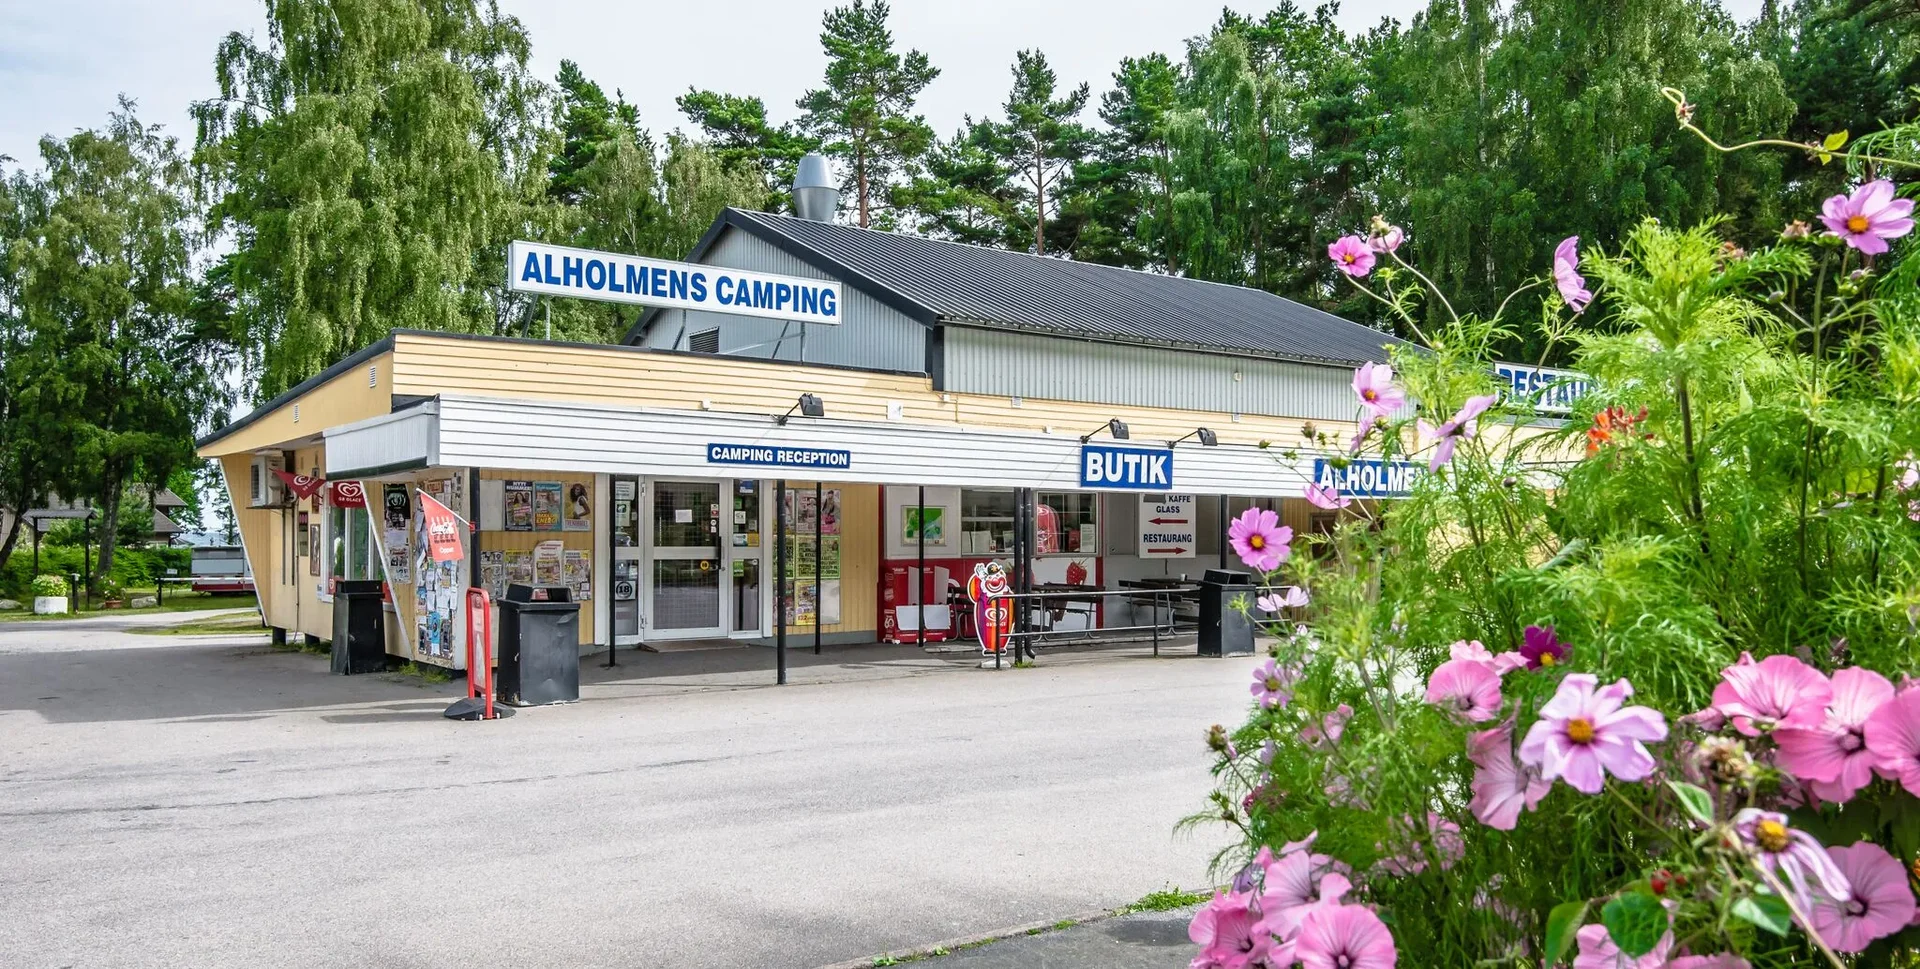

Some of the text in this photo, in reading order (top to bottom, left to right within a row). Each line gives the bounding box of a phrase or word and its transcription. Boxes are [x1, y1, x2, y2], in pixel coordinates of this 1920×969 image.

[521, 251, 837, 317] ALHOLMENS CAMPING
[711, 446, 848, 466] CAMPING RECEPTION
[1085, 451, 1168, 485] BUTIK
[1168, 494, 1191, 503] KAFFE
[1156, 505, 1180, 514] GLASS
[1143, 533, 1192, 543] RESTAURANG
[618, 585, 630, 593] 18
